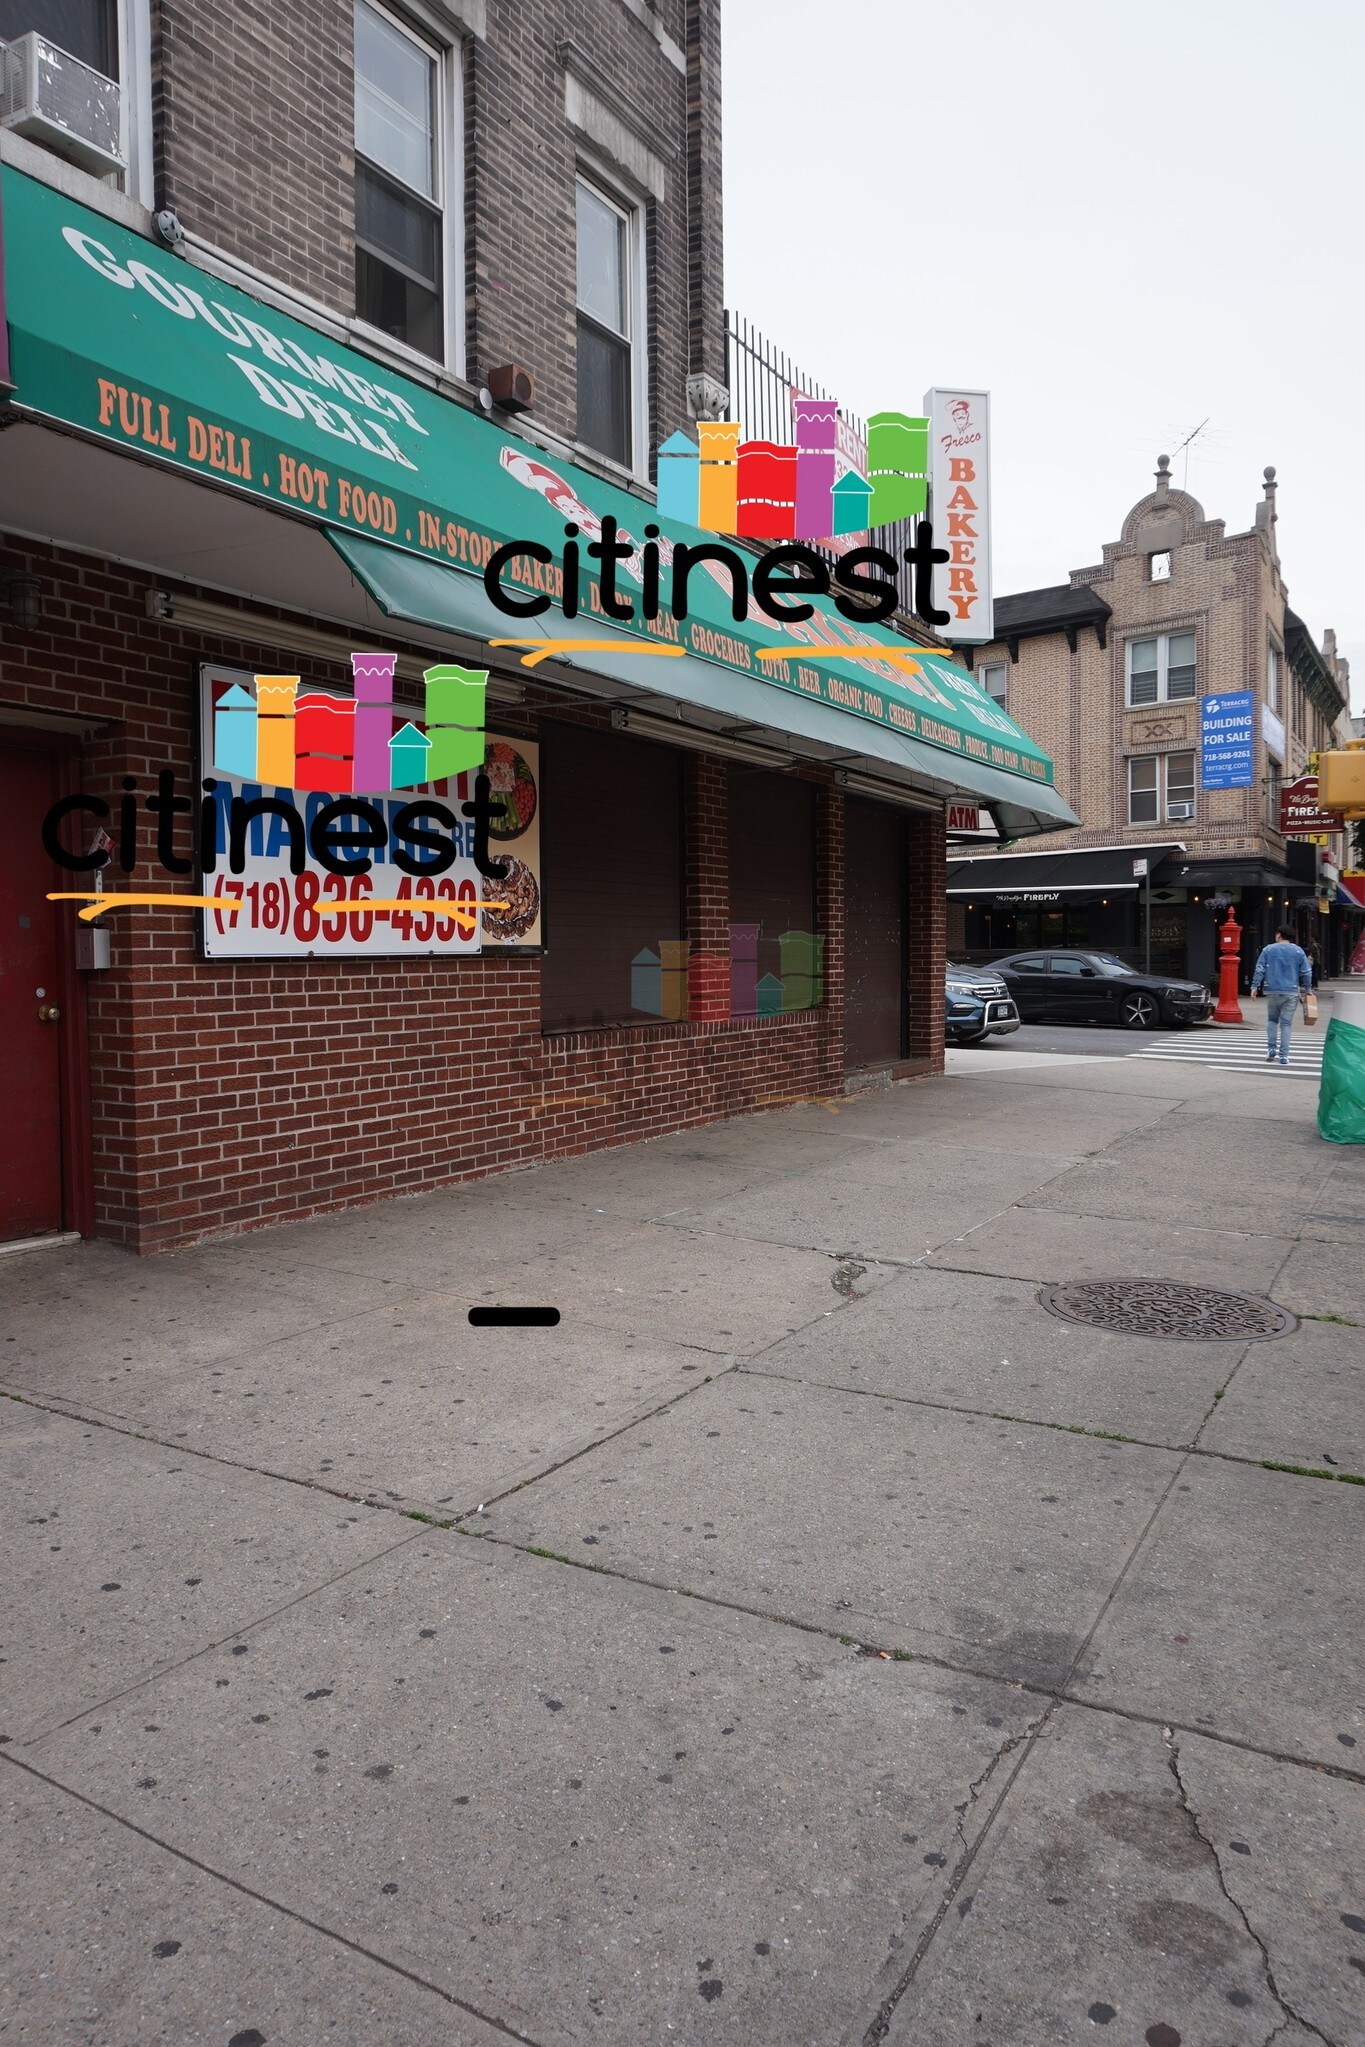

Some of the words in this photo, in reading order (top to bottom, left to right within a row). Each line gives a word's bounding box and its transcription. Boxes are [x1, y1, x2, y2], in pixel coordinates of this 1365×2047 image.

[62, 226, 430, 436] GOURMET
[226, 353, 419, 472] DELI
[941, 432, 982, 454] Fresco
[946, 458, 979, 619] BAKERY
[97, 378, 177, 453] FULL
[187, 415, 252, 481] DELI
[278, 453, 330, 510] HOT
[337, 477, 398, 535] FOOD
[511, 552, 564, 599] BAKER
[690, 622, 751, 670] GROCERIES
[761, 657, 790, 684] LOTTO
[797, 665, 821, 696] BEER
[827, 677, 863, 711] ORGANIC
[864, 691, 883, 718] FOOD
[889, 702, 917, 732] CHEESES
[1203, 716, 1252, 731] BUILDING
[1204, 734, 1224, 746] FOR
[1226, 731, 1251, 744] SALE
[1204, 750, 1250, 762] 718-568-9261
[1205, 762, 1248, 772] terracrg.com
[949, 806, 978, 828] ATM
[1023, 893, 1060, 901] FIREFLY
